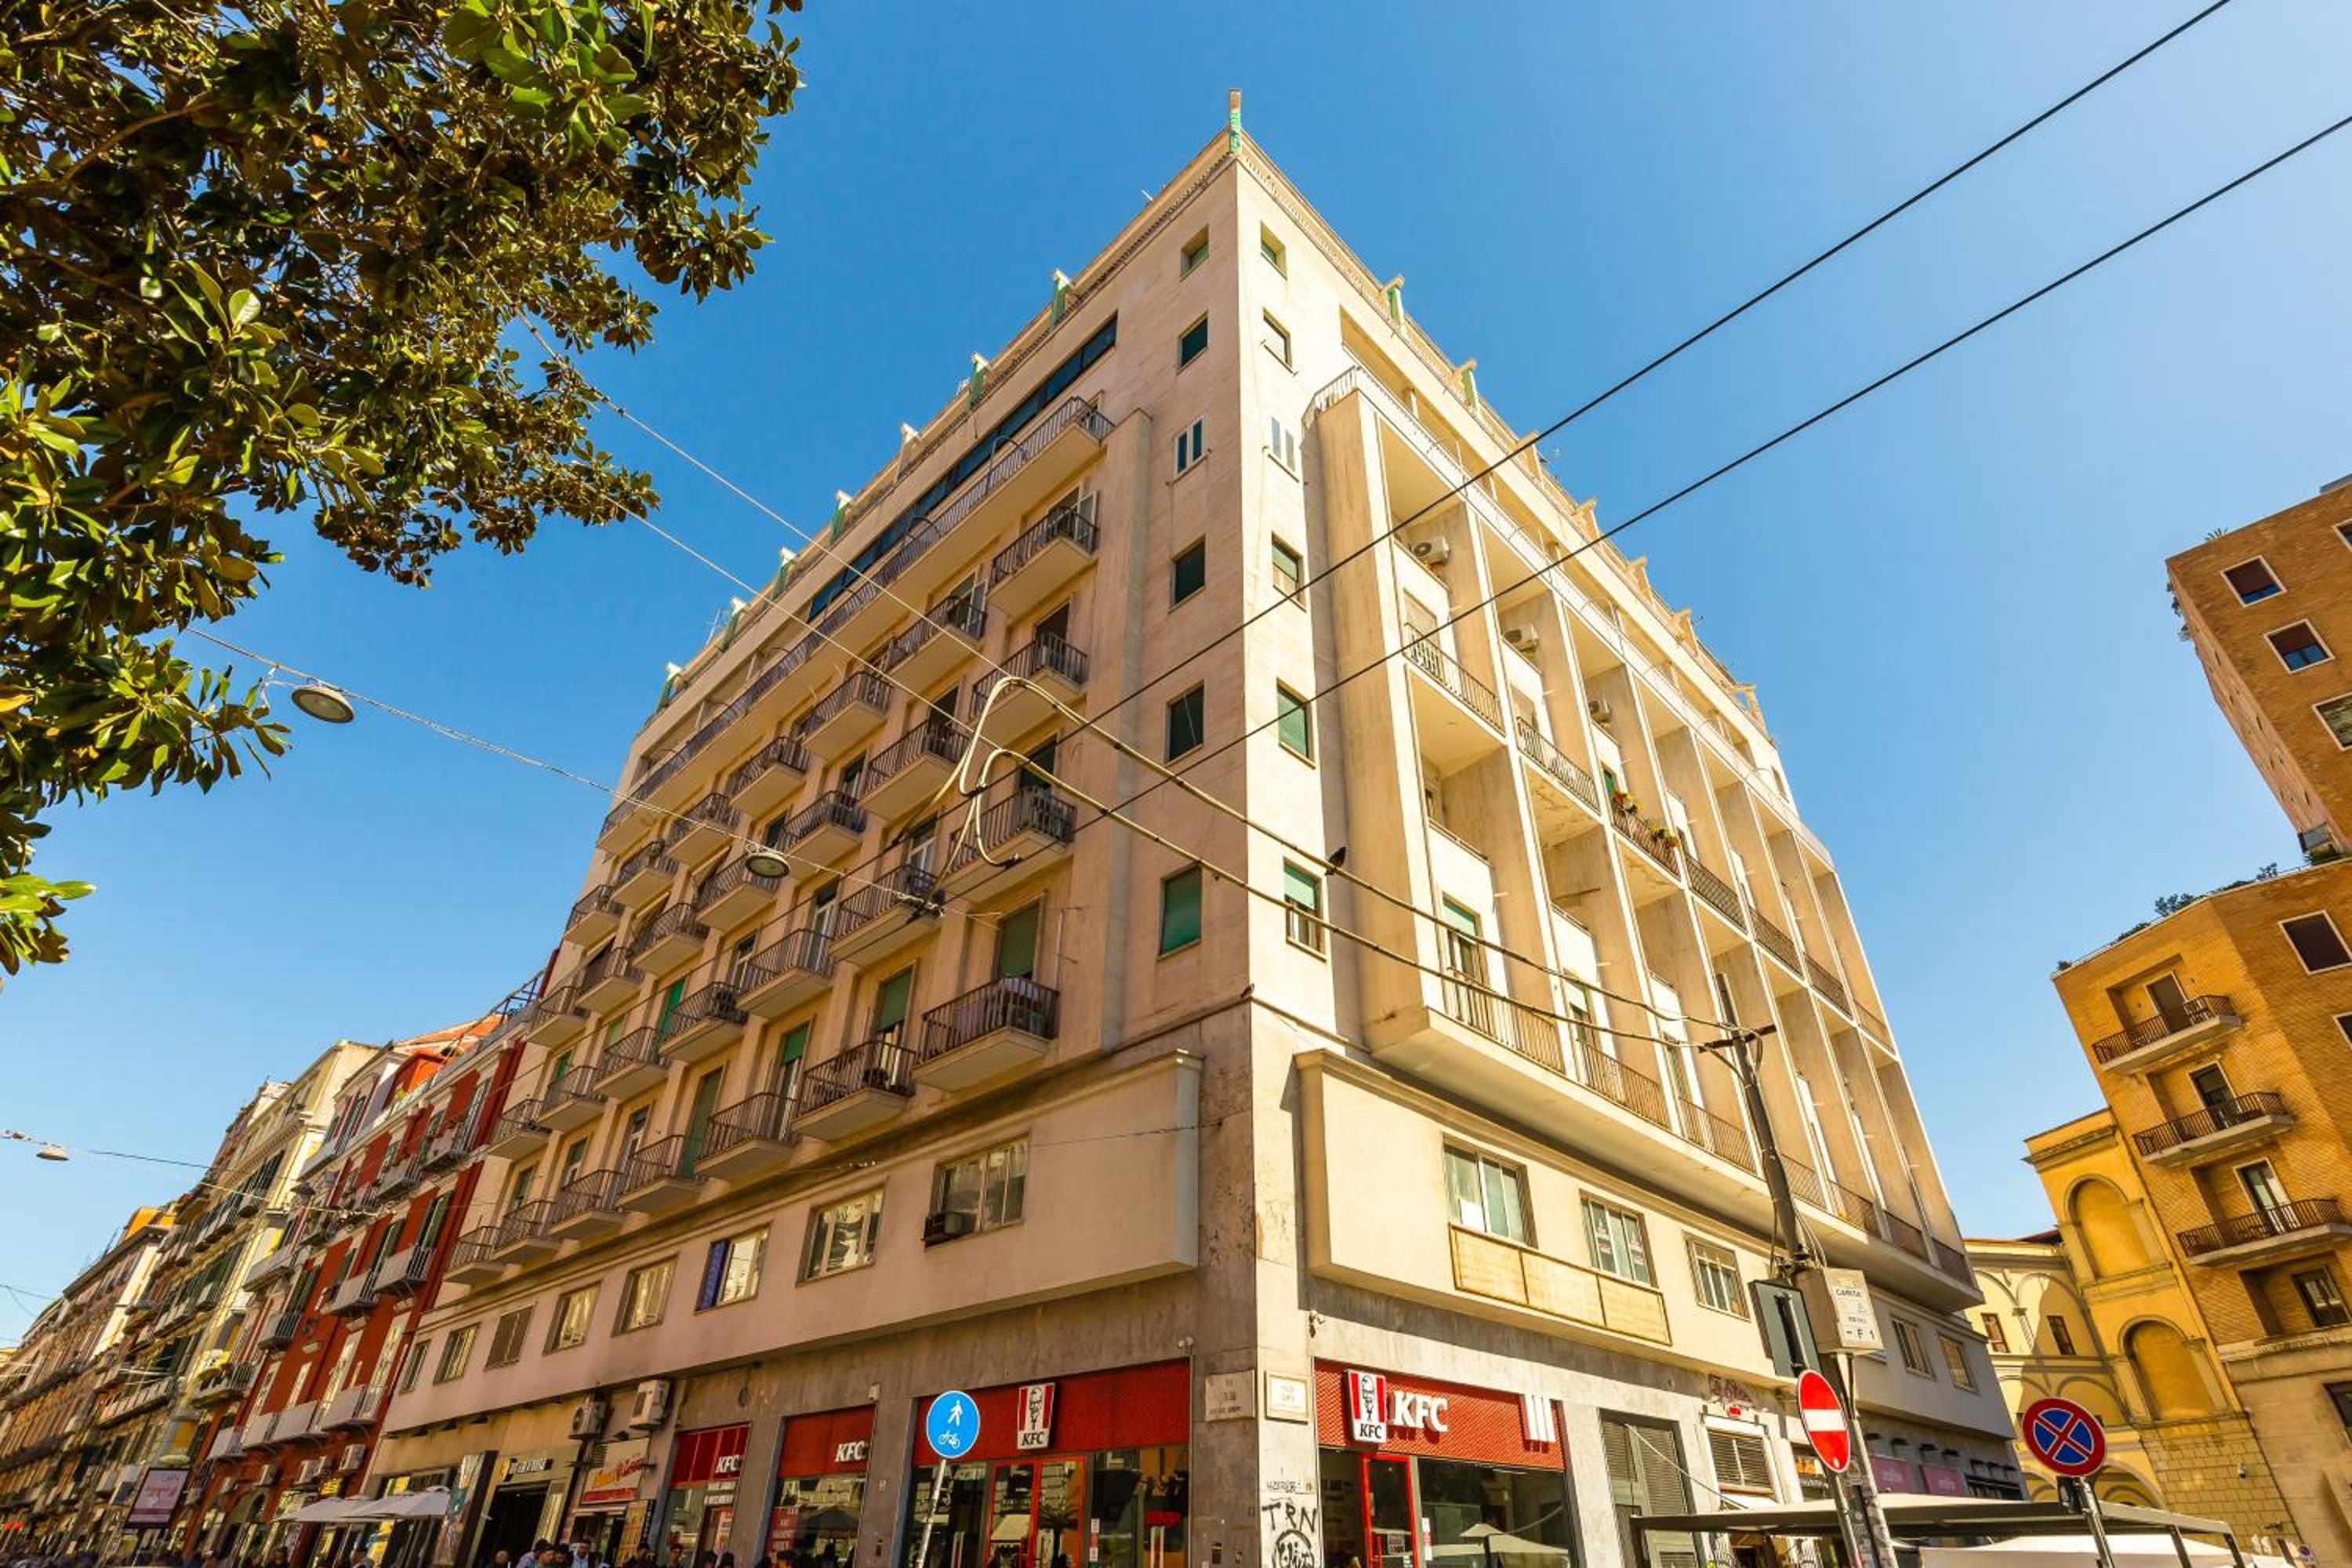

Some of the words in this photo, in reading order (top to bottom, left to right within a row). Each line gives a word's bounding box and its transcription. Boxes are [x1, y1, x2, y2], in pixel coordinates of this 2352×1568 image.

[1393, 1390, 1448, 1432] KFC
[1022, 1431, 1044, 1446] KFC
[1359, 1423, 1382, 1439] KFC
[834, 1440, 866, 1462] KFC
[714, 1454, 739, 1473] KFC
